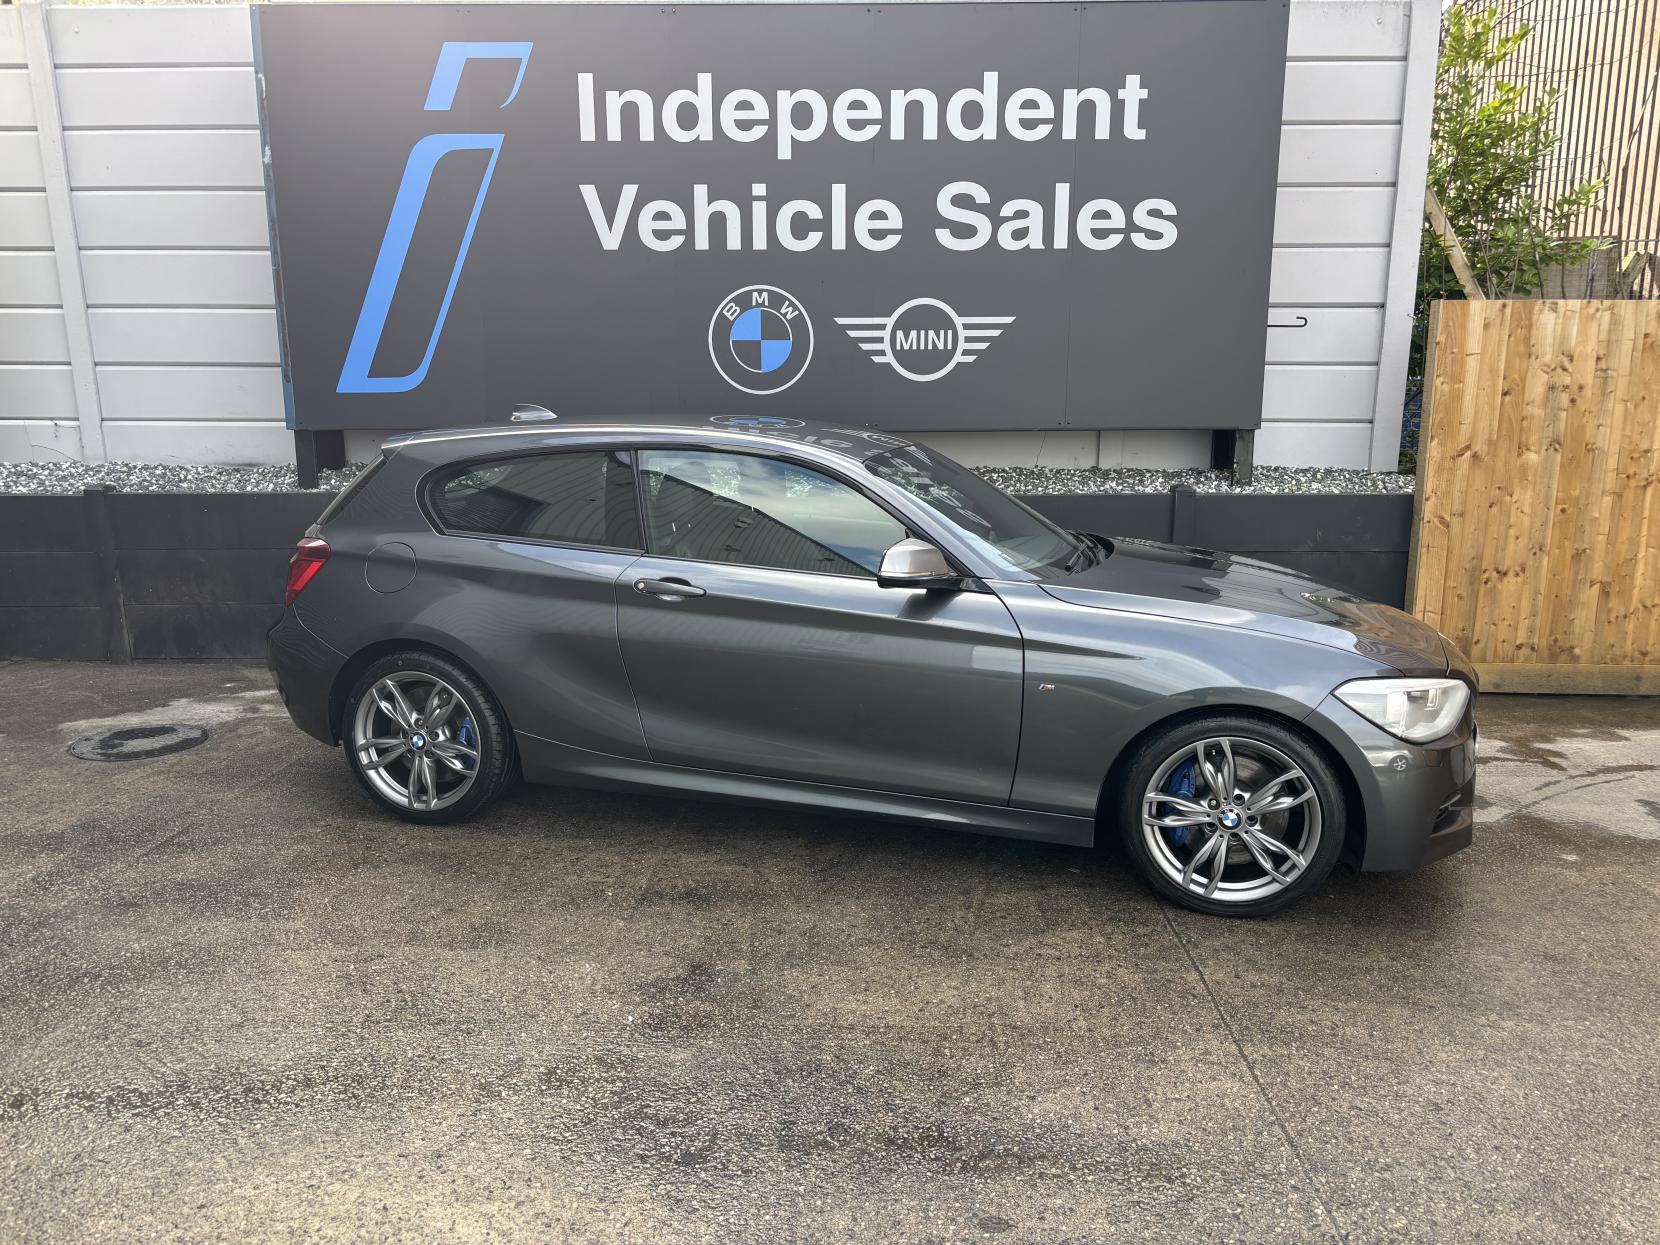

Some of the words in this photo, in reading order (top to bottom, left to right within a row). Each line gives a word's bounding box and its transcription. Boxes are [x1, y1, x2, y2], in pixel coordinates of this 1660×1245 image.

[577, 71, 1149, 160] Independent
[578, 181, 904, 252] Vehicle
[934, 181, 1178, 252] Sales
[722, 291, 800, 321] BMW
[895, 329, 954, 351] MINI
